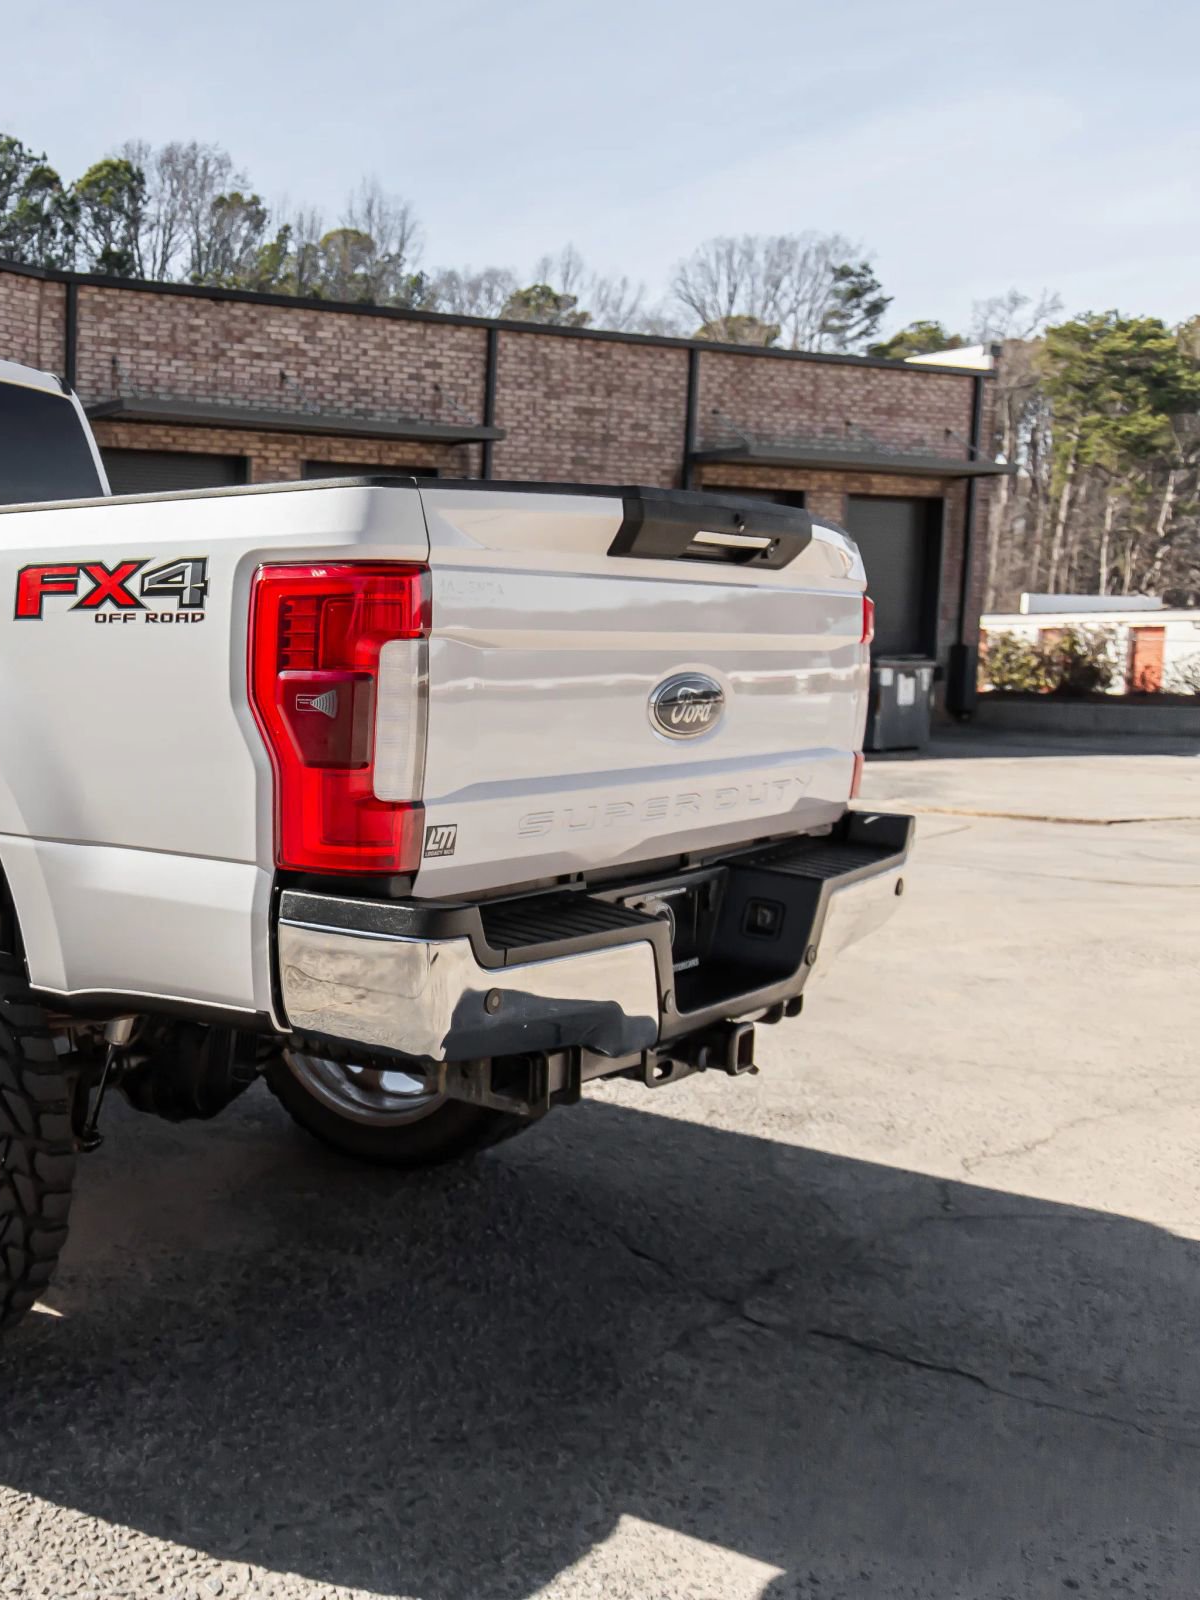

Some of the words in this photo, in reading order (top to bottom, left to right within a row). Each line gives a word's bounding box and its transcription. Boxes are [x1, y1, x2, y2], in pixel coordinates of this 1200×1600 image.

[14, 557, 209, 620] FX4
[95, 612, 136, 624] OFF
[145, 612, 205, 624] ROAD
[671, 687, 712, 724] Ford
[516, 791, 702, 840] SUPER
[715, 775, 814, 811] DUTY
